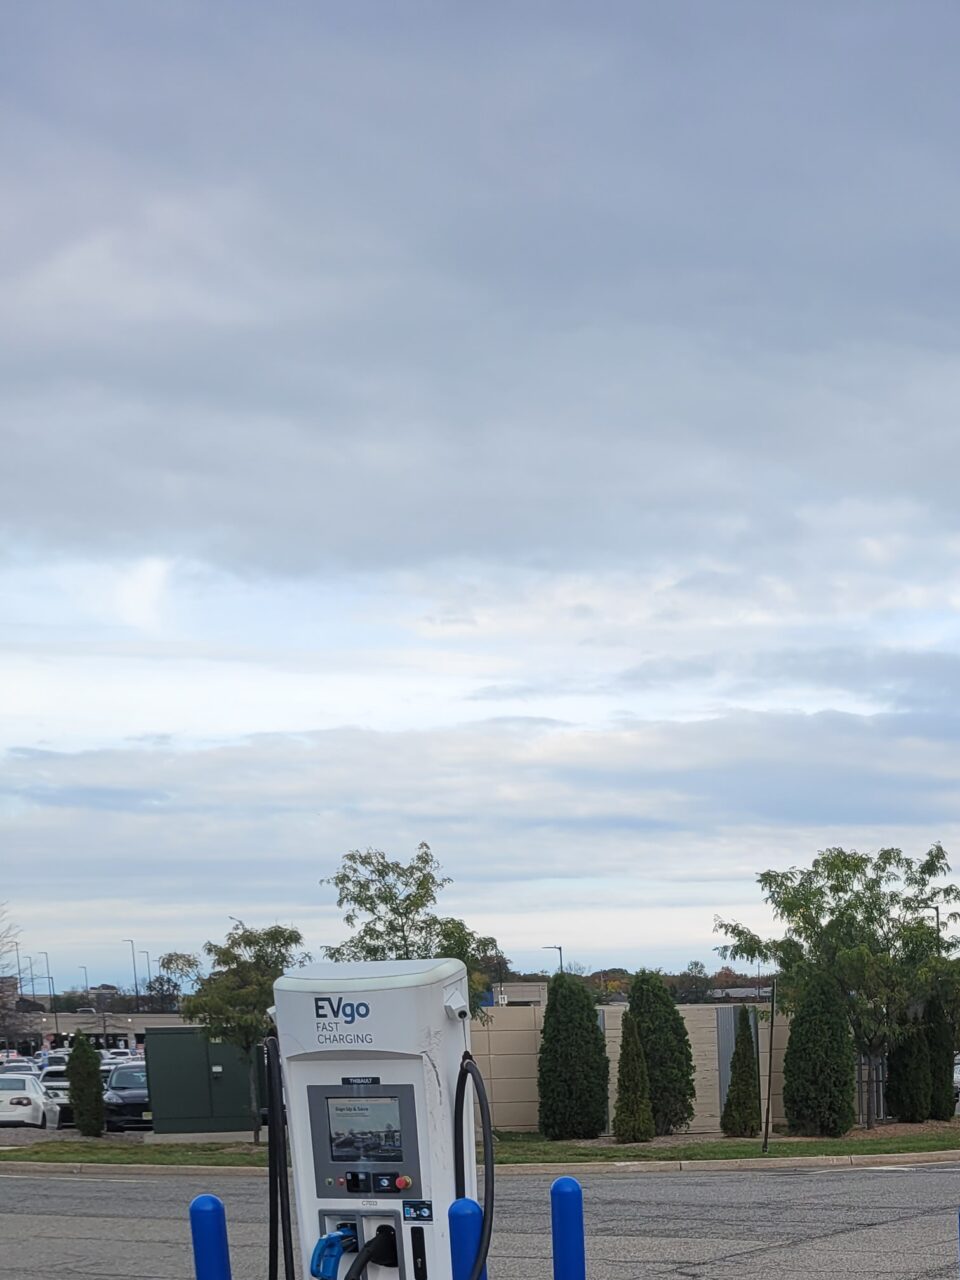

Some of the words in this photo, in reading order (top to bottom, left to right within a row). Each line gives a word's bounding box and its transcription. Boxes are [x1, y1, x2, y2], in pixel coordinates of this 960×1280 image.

[314, 997, 370, 1024] EVgo
[316, 1021, 340, 1032] FAST
[317, 1034, 373, 1044] CHARGING
